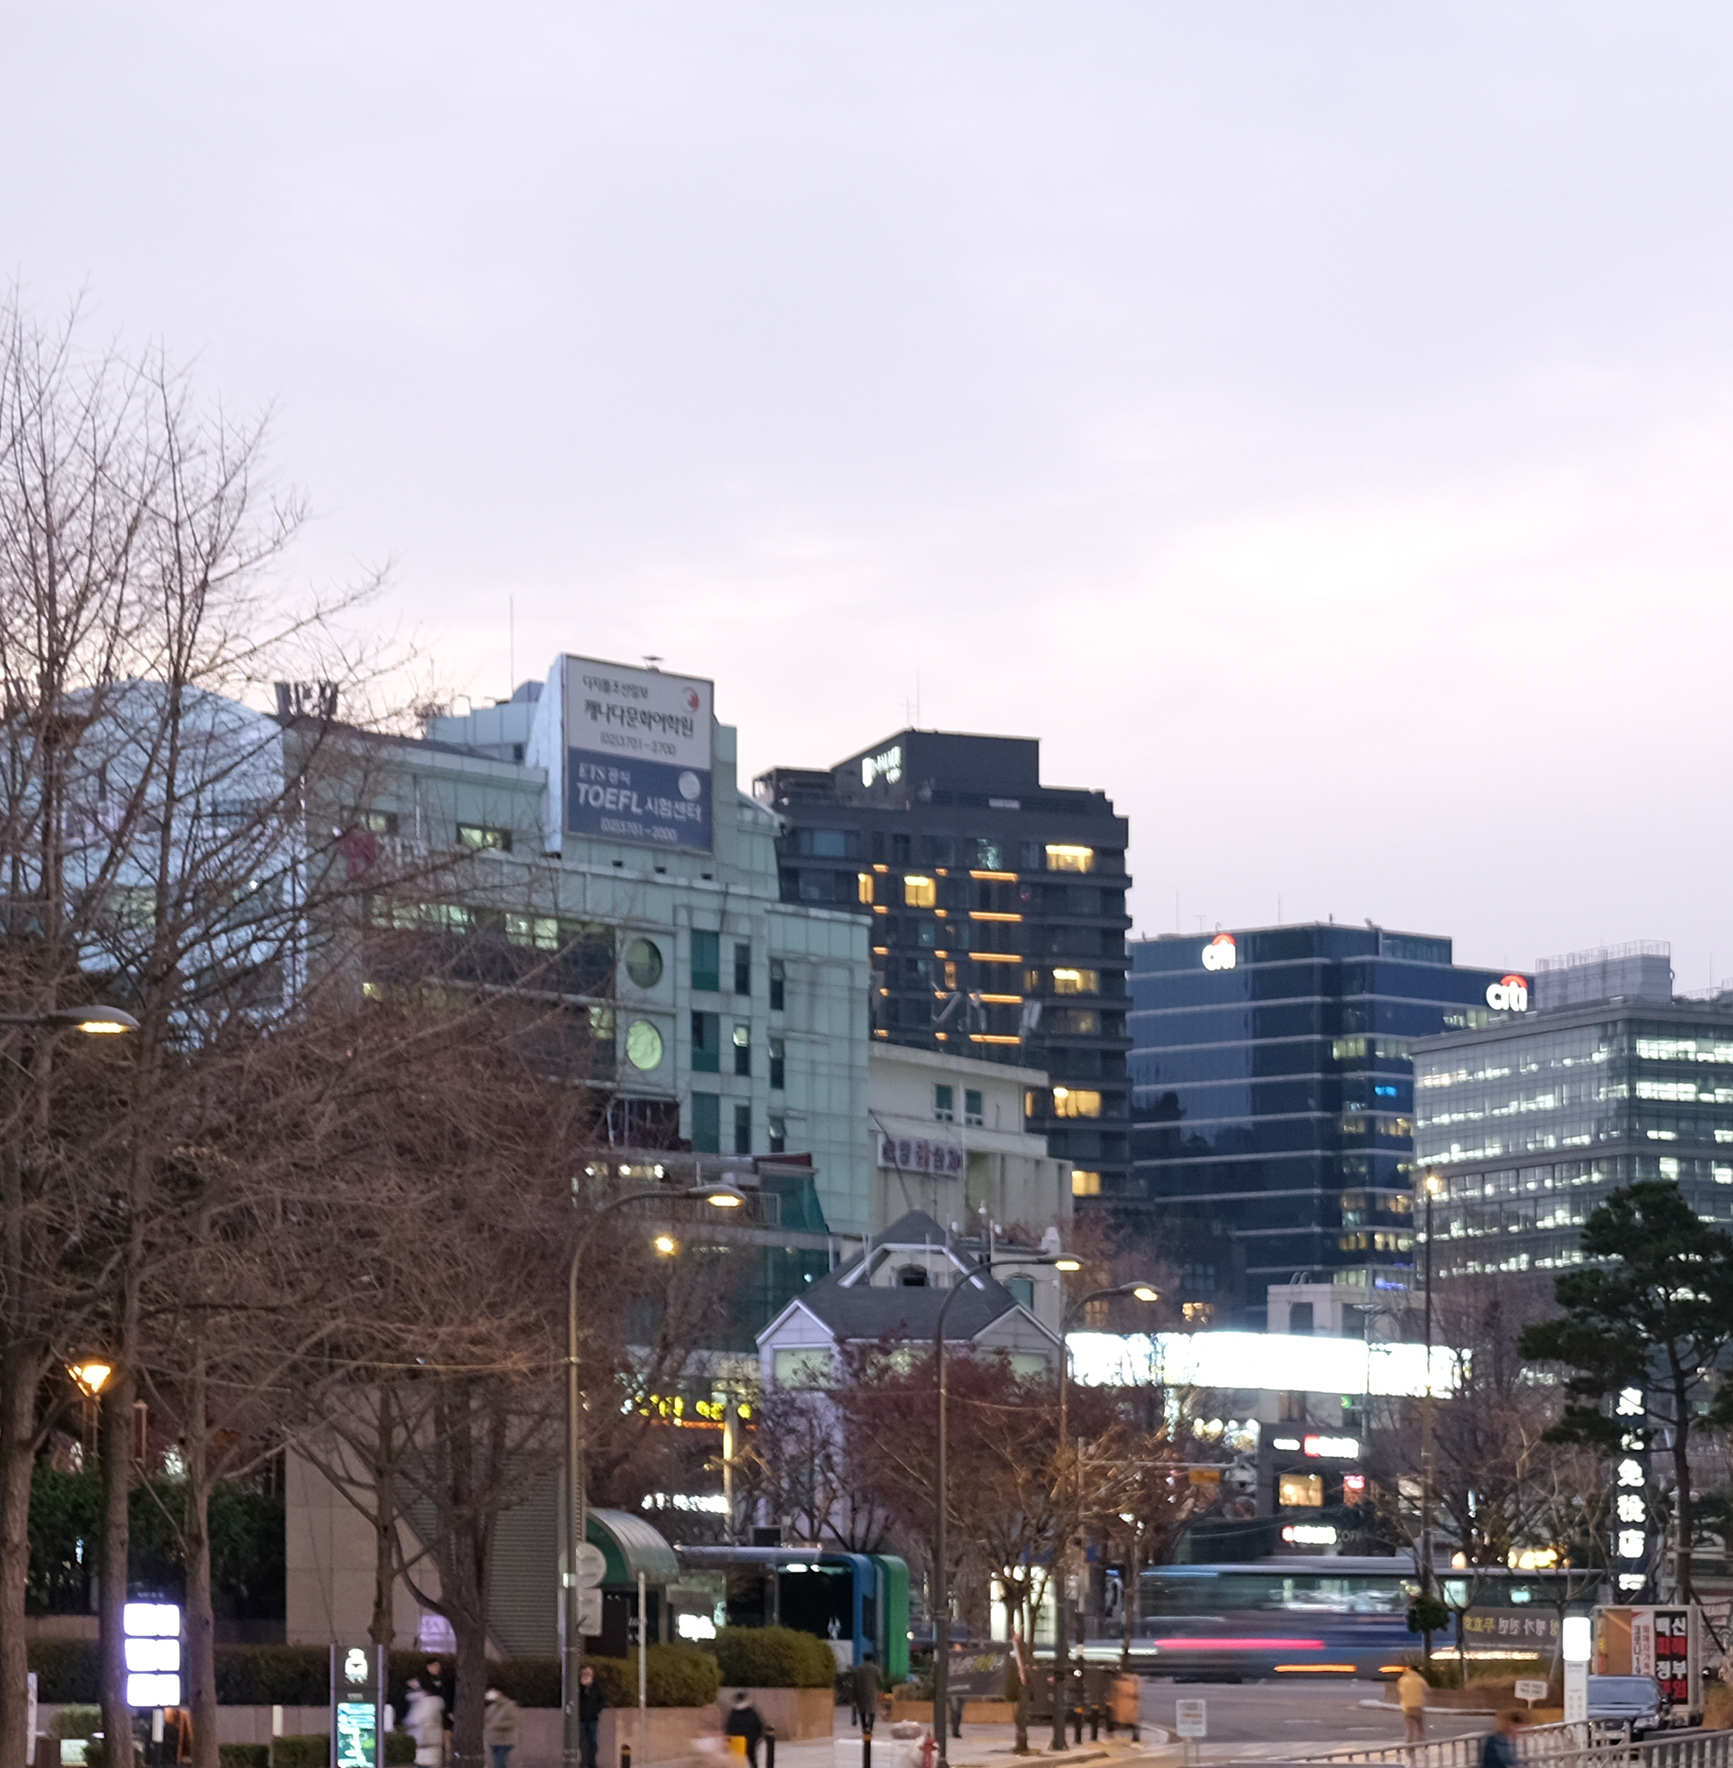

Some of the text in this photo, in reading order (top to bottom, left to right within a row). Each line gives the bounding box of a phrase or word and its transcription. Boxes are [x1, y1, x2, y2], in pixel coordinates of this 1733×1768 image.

[576, 783, 644, 816] TOEFL
[1486, 977, 1528, 1012] citi
[1656, 1617, 1687, 1637] 백신
[1656, 1660, 1687, 1681] 정부
